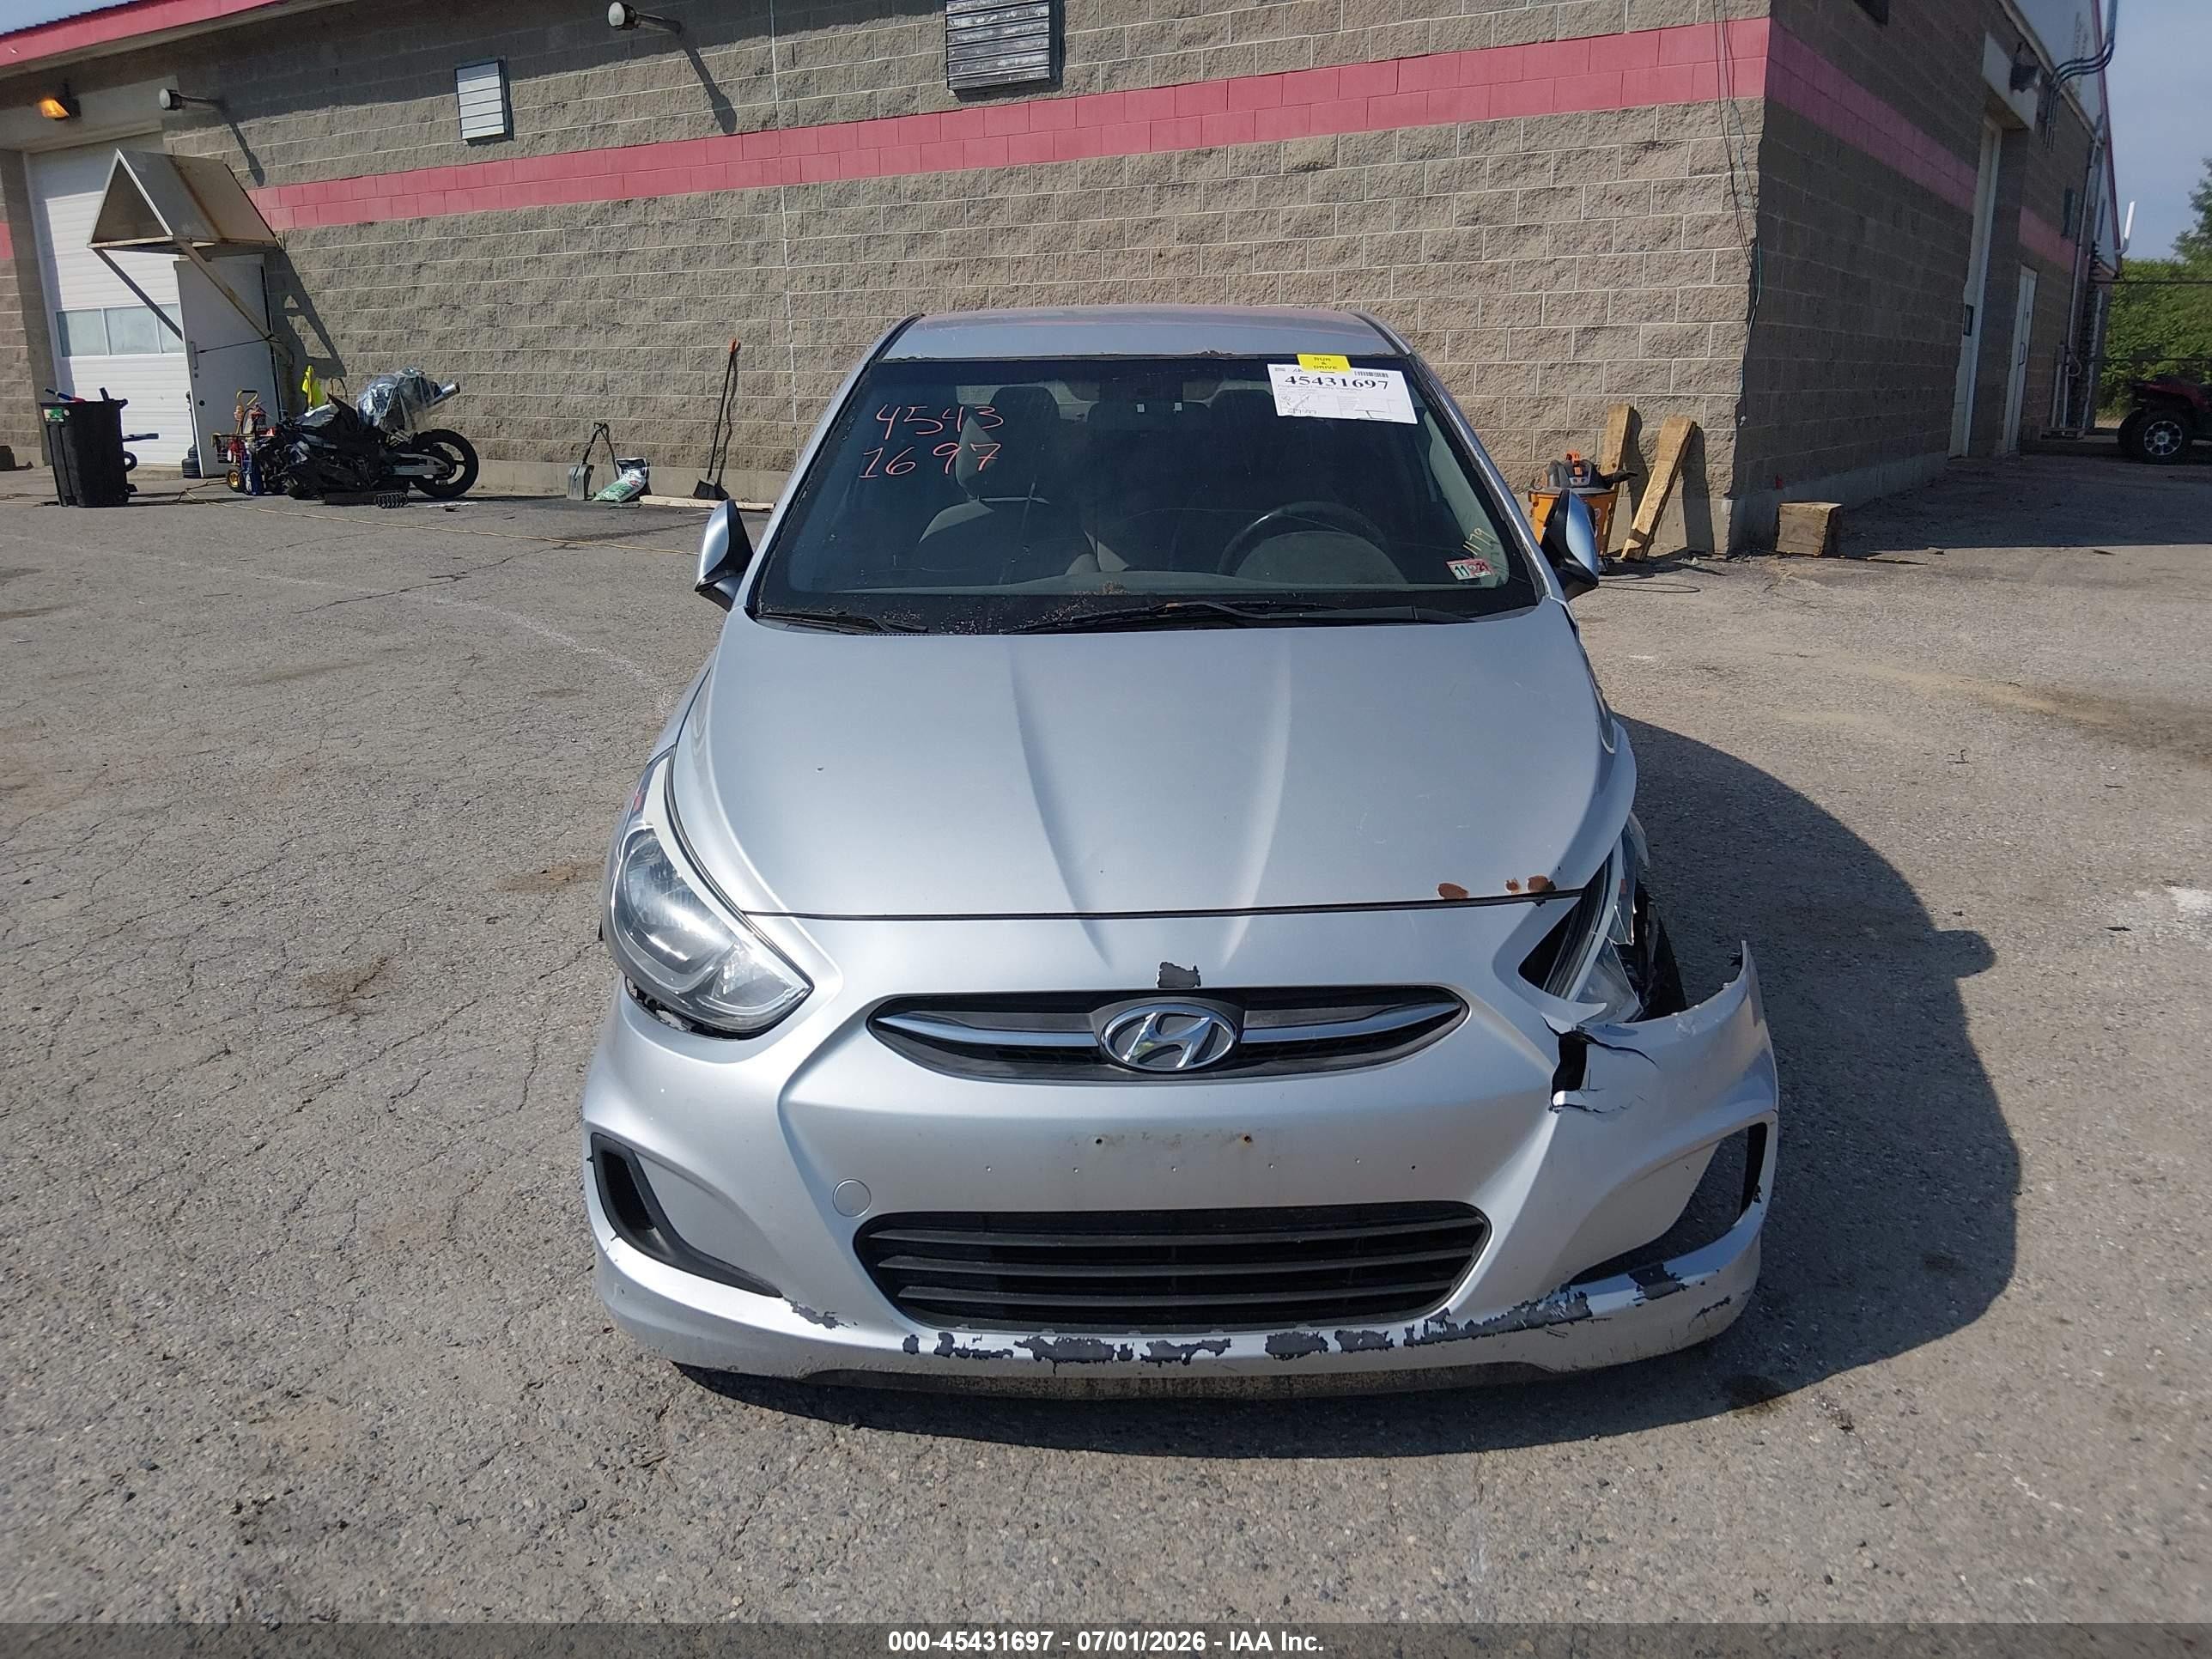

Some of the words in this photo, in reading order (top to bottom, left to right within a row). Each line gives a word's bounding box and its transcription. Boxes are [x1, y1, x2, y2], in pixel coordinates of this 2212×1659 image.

[1285, 375, 1389, 391] 45431697
[876, 404, 1004, 441] 4543
[1455, 564, 1469, 576] 11
